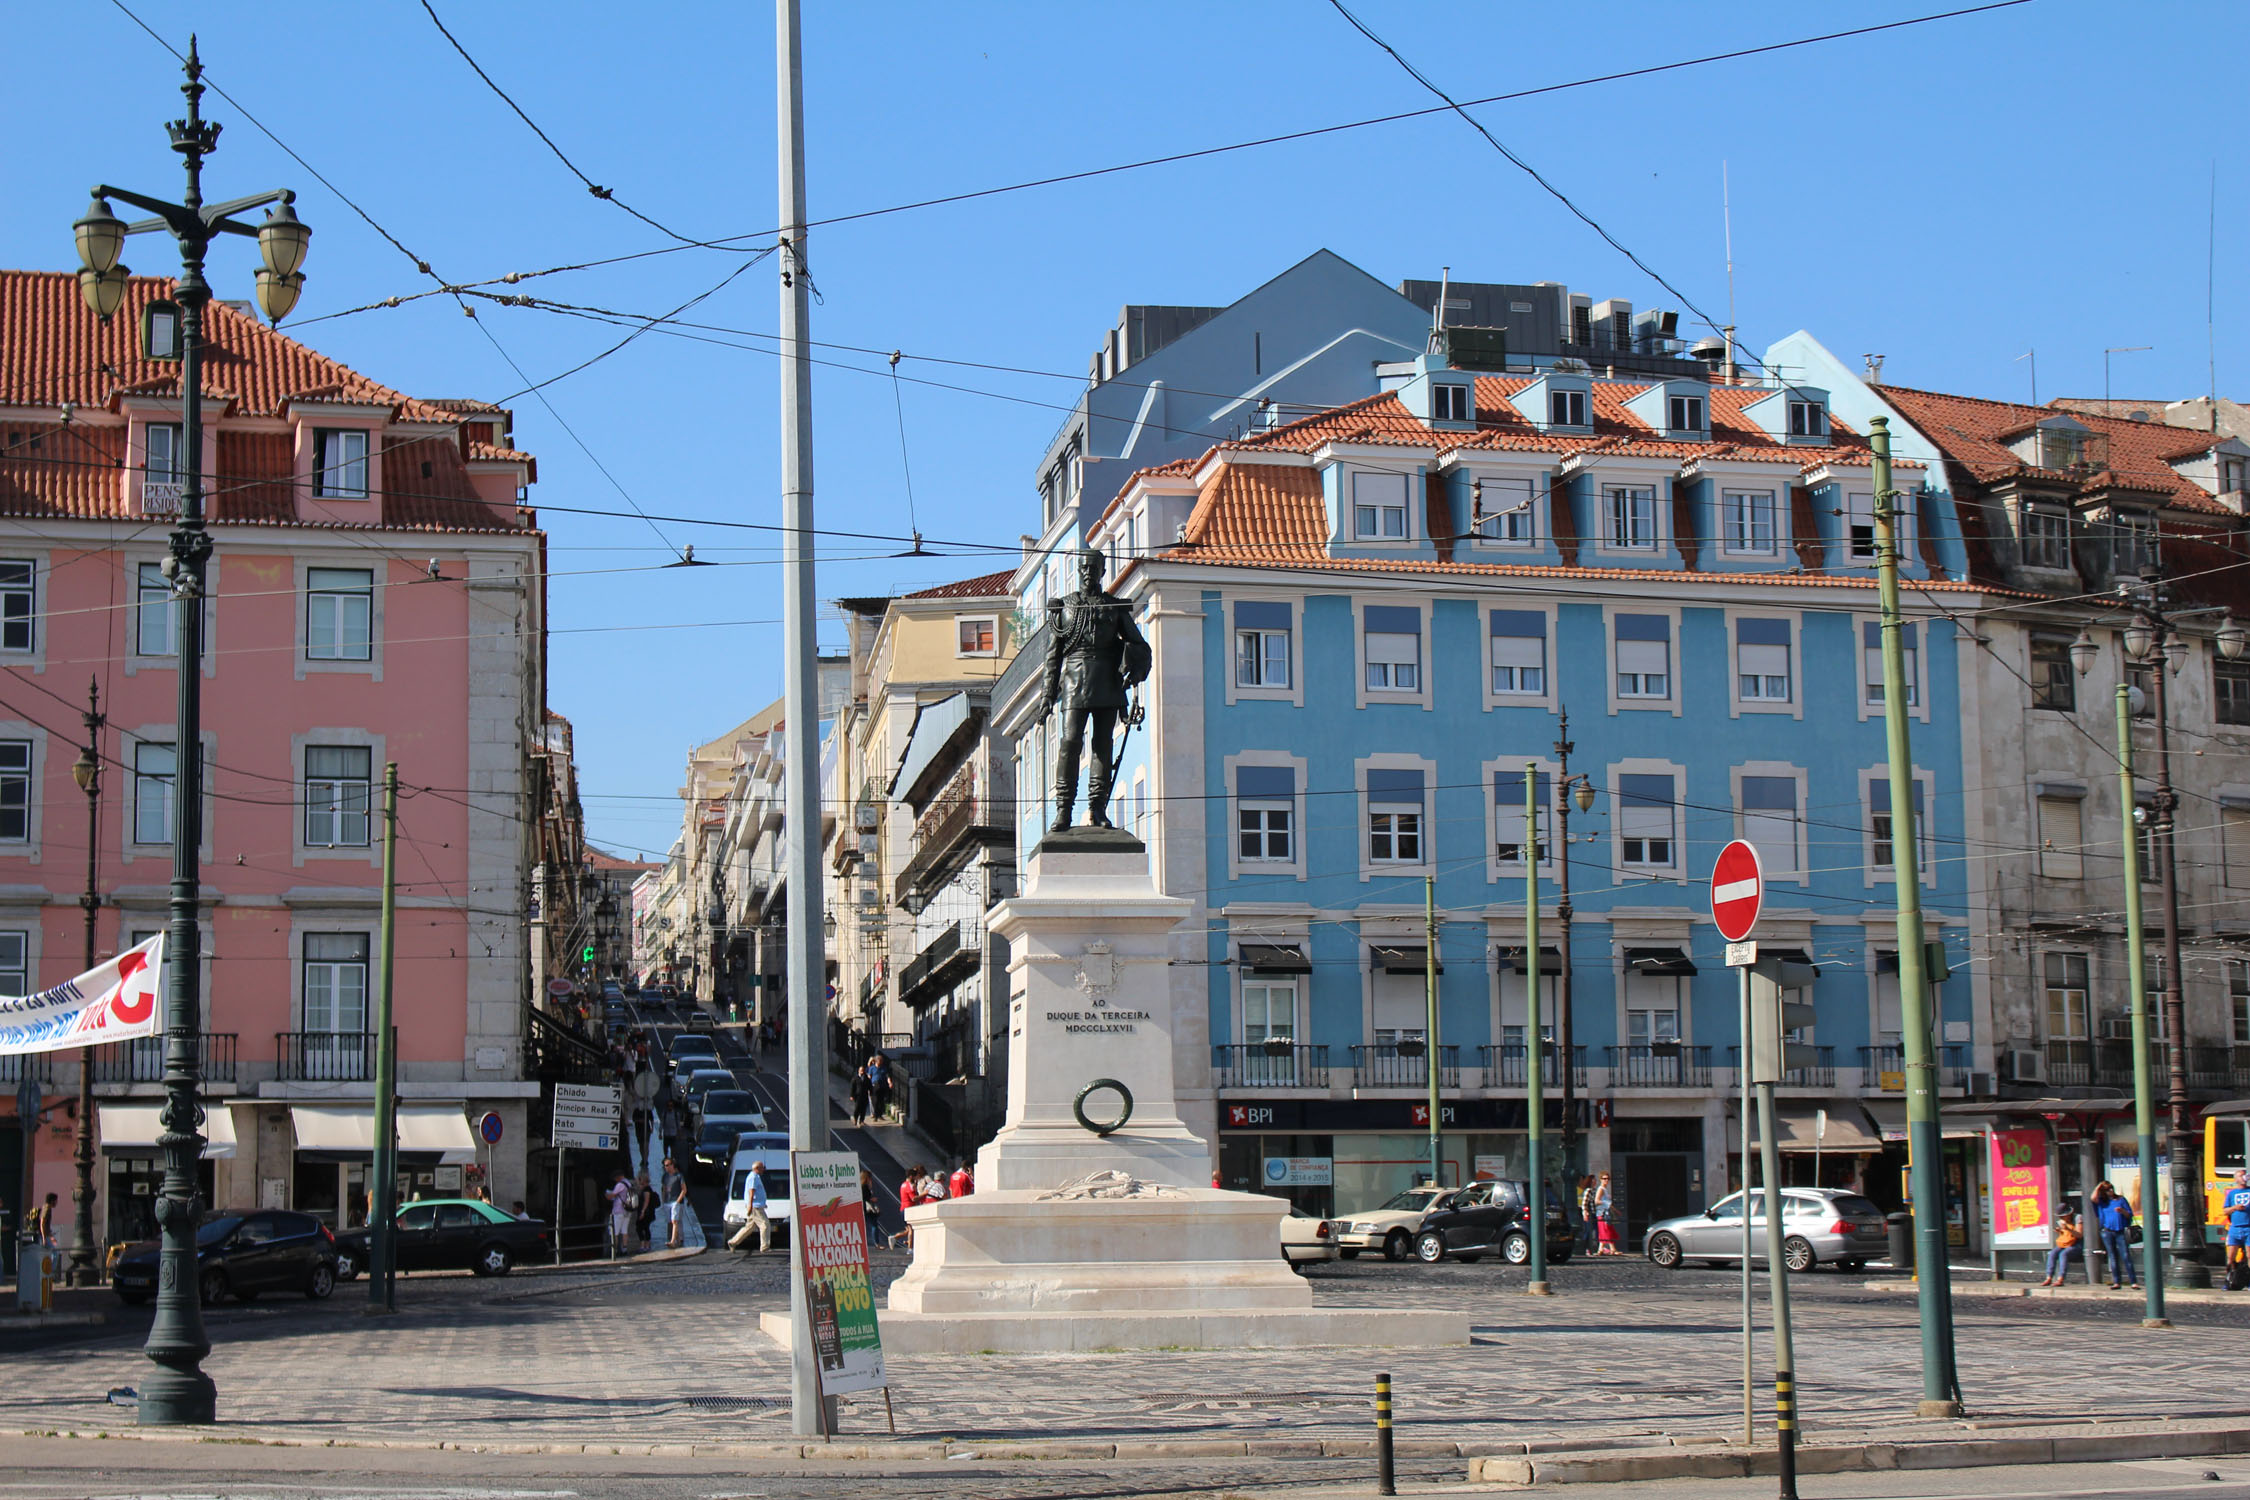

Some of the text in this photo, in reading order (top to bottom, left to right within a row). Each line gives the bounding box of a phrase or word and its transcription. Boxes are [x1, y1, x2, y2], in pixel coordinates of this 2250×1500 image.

[1092, 1000, 1106, 1008] AO
[1047, 1011, 1151, 1021] DUQUE DA TERCEIRA
[1066, 1024, 1133, 1033] MDCCCLXXVII
[557, 1087, 586, 1097] Chiado
[591, 1105, 608, 1114] Real
[1441, 1107, 1455, 1122] PI
[1248, 1108, 1273, 1123] BPI
[555, 1119, 575, 1128] Rato
[554, 1139, 582, 1148] Camões
[2003, 1138, 2032, 1167] 20
[800, 1164, 824, 1178] Lisboa
[829, 1164, 834, 1177] 6
[835, 1163, 856, 1181] Junho
[1290, 1174, 1306, 1182] 2014
[1313, 1174, 1329, 1182] 2015
[805, 1222, 862, 1247] MARCHA
[808, 1244, 865, 1268] NACIONAL
[834, 1286, 871, 1313] POVO
